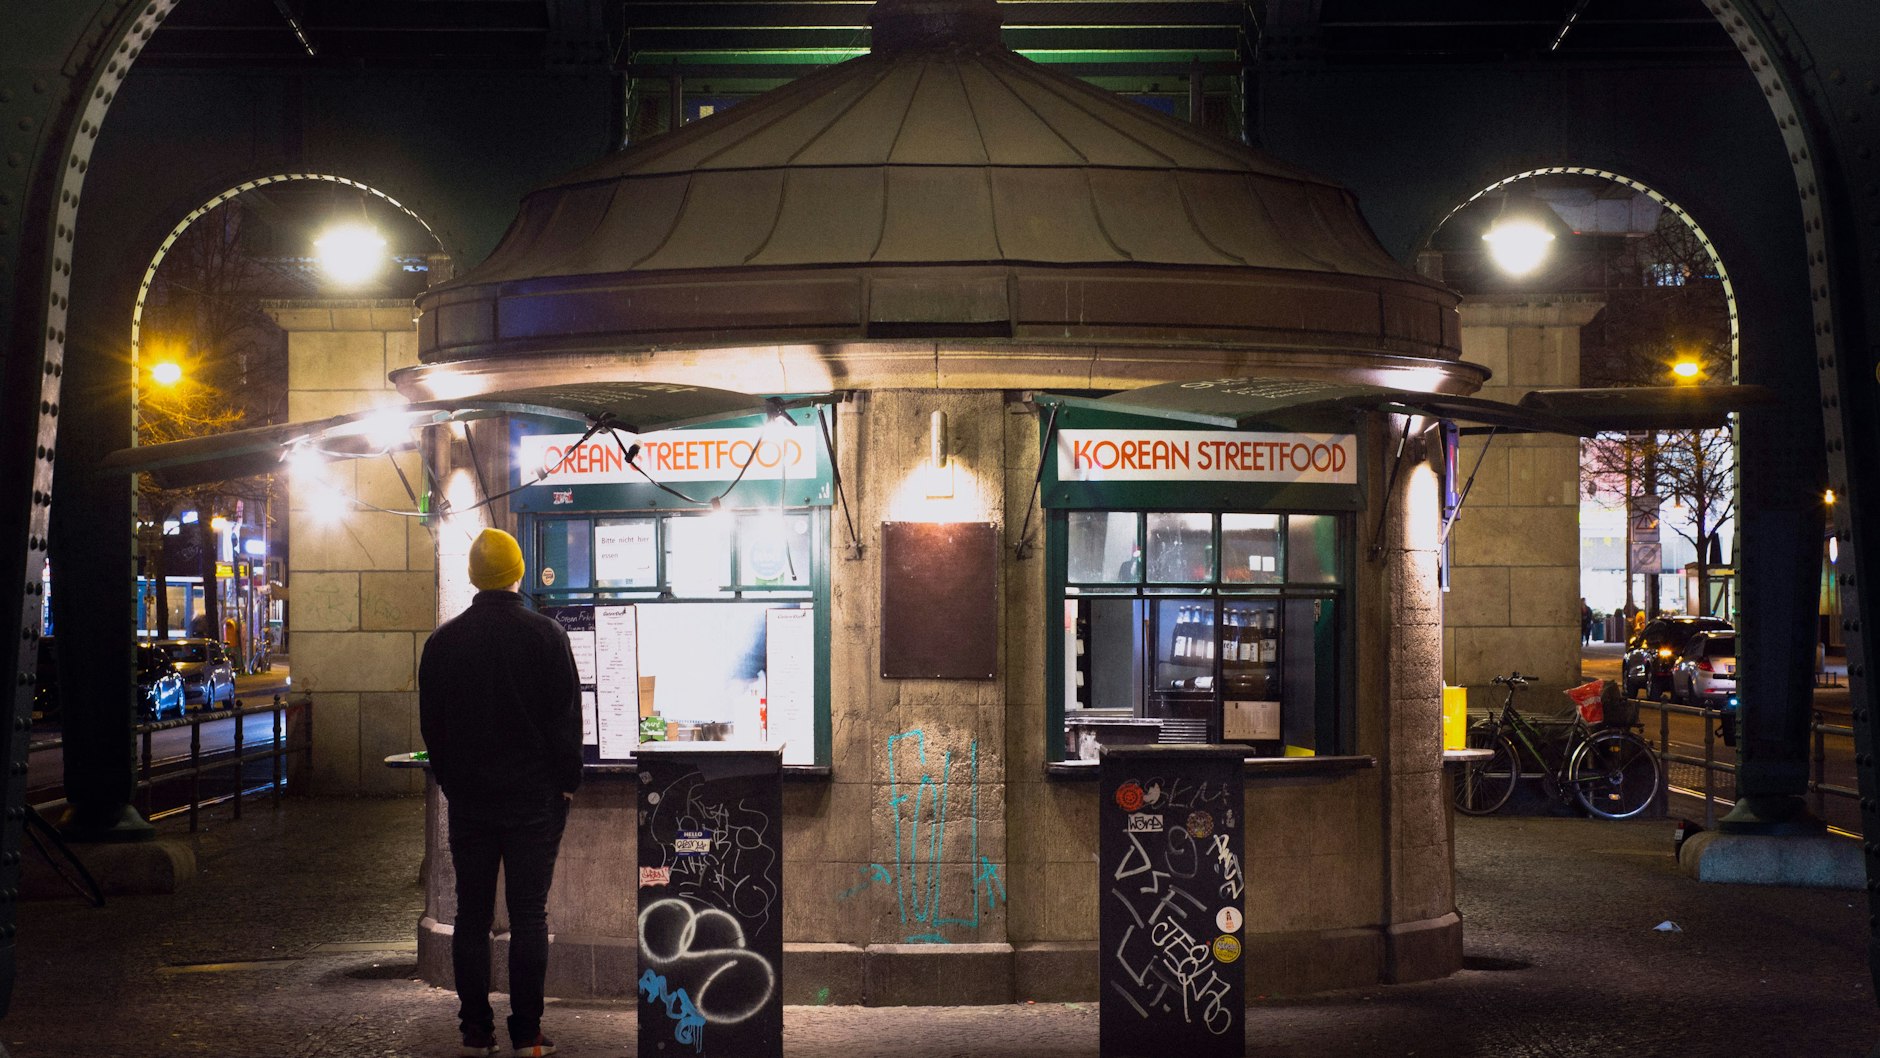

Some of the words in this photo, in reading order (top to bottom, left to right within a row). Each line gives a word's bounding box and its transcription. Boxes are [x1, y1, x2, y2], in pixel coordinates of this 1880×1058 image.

[532, 442, 622, 474] OREAN
[1074, 440, 1190, 471] KOREAN
[1197, 441, 1346, 473] STREETFOOD
[637, 535, 649, 543] hier
